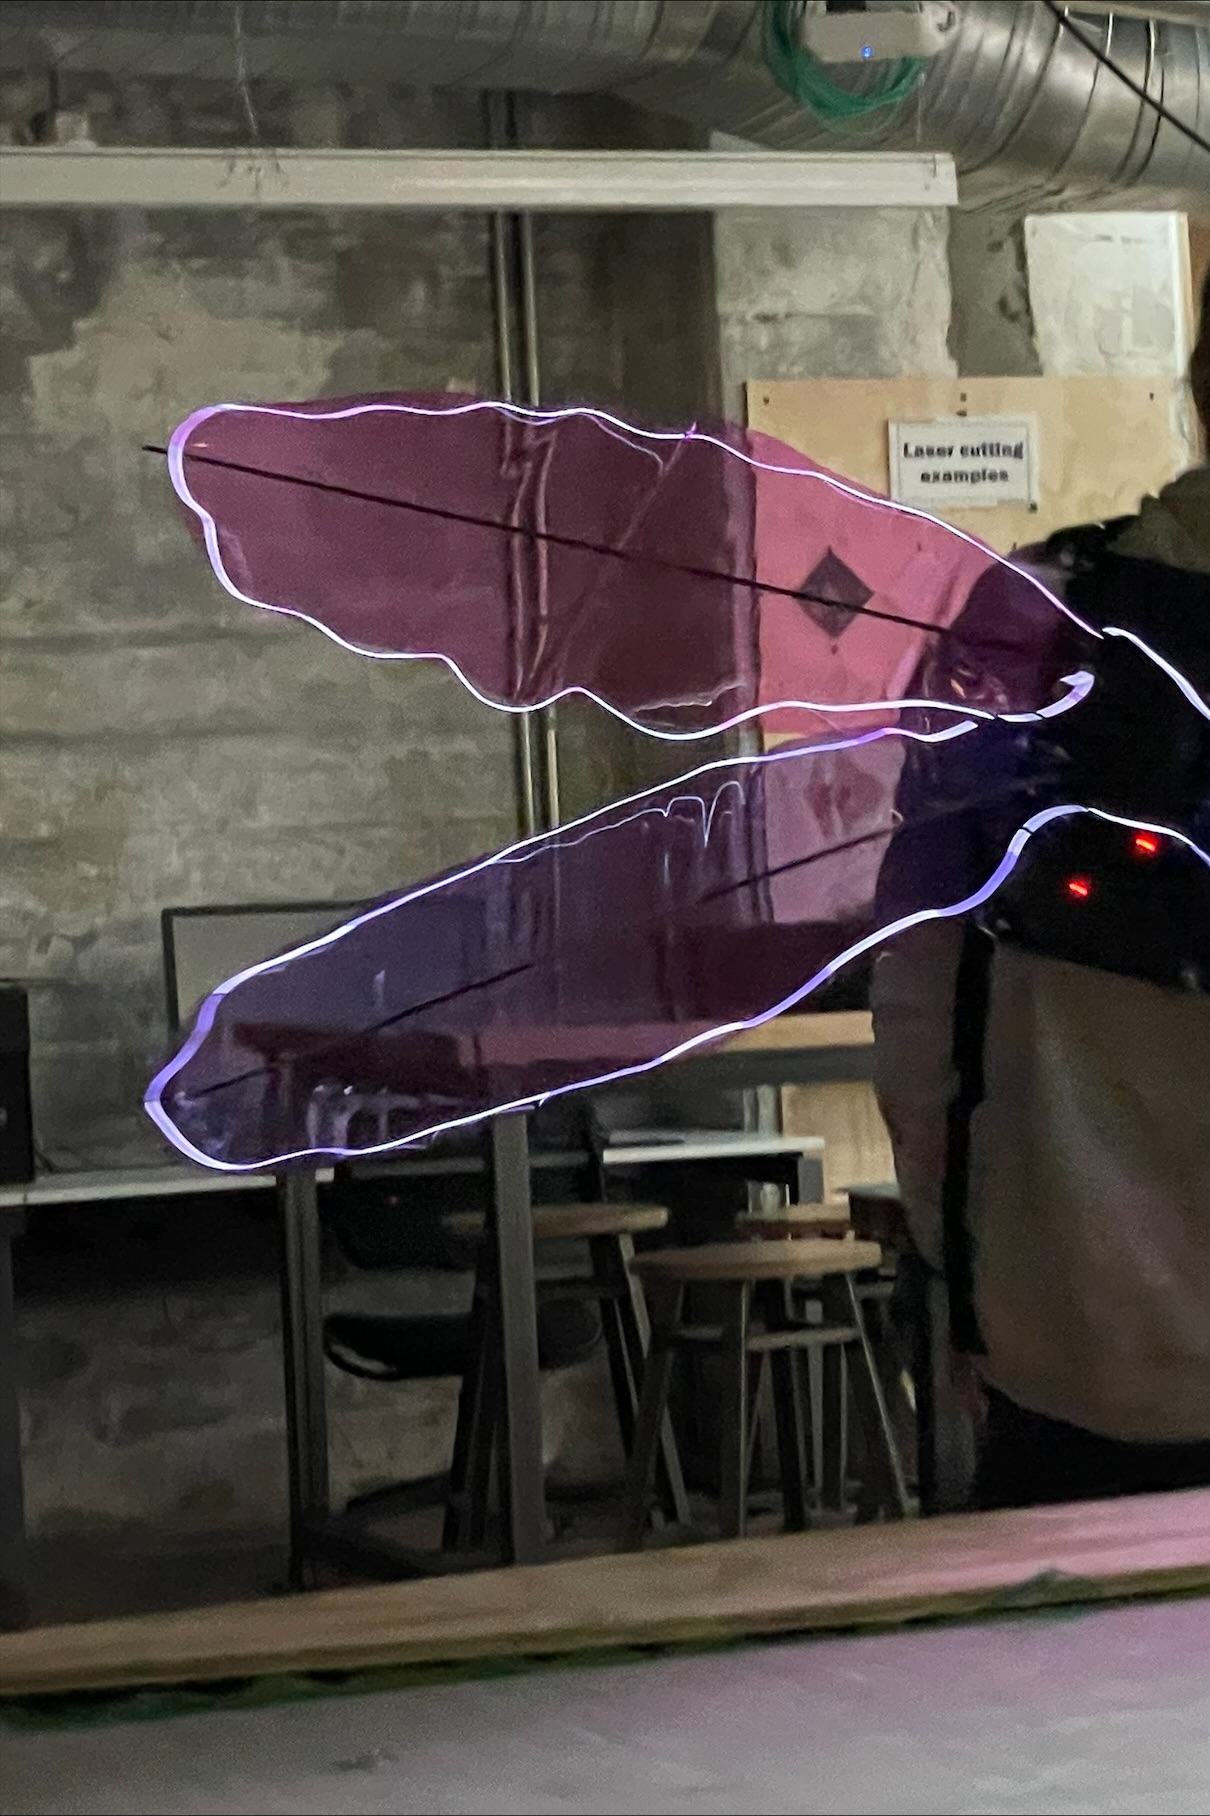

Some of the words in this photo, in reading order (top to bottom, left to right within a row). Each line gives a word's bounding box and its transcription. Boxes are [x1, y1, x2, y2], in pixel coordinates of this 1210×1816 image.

[903, 442, 954, 459] Laser
[960, 441, 1024, 460] cutting
[920, 468, 1009, 484] examples
